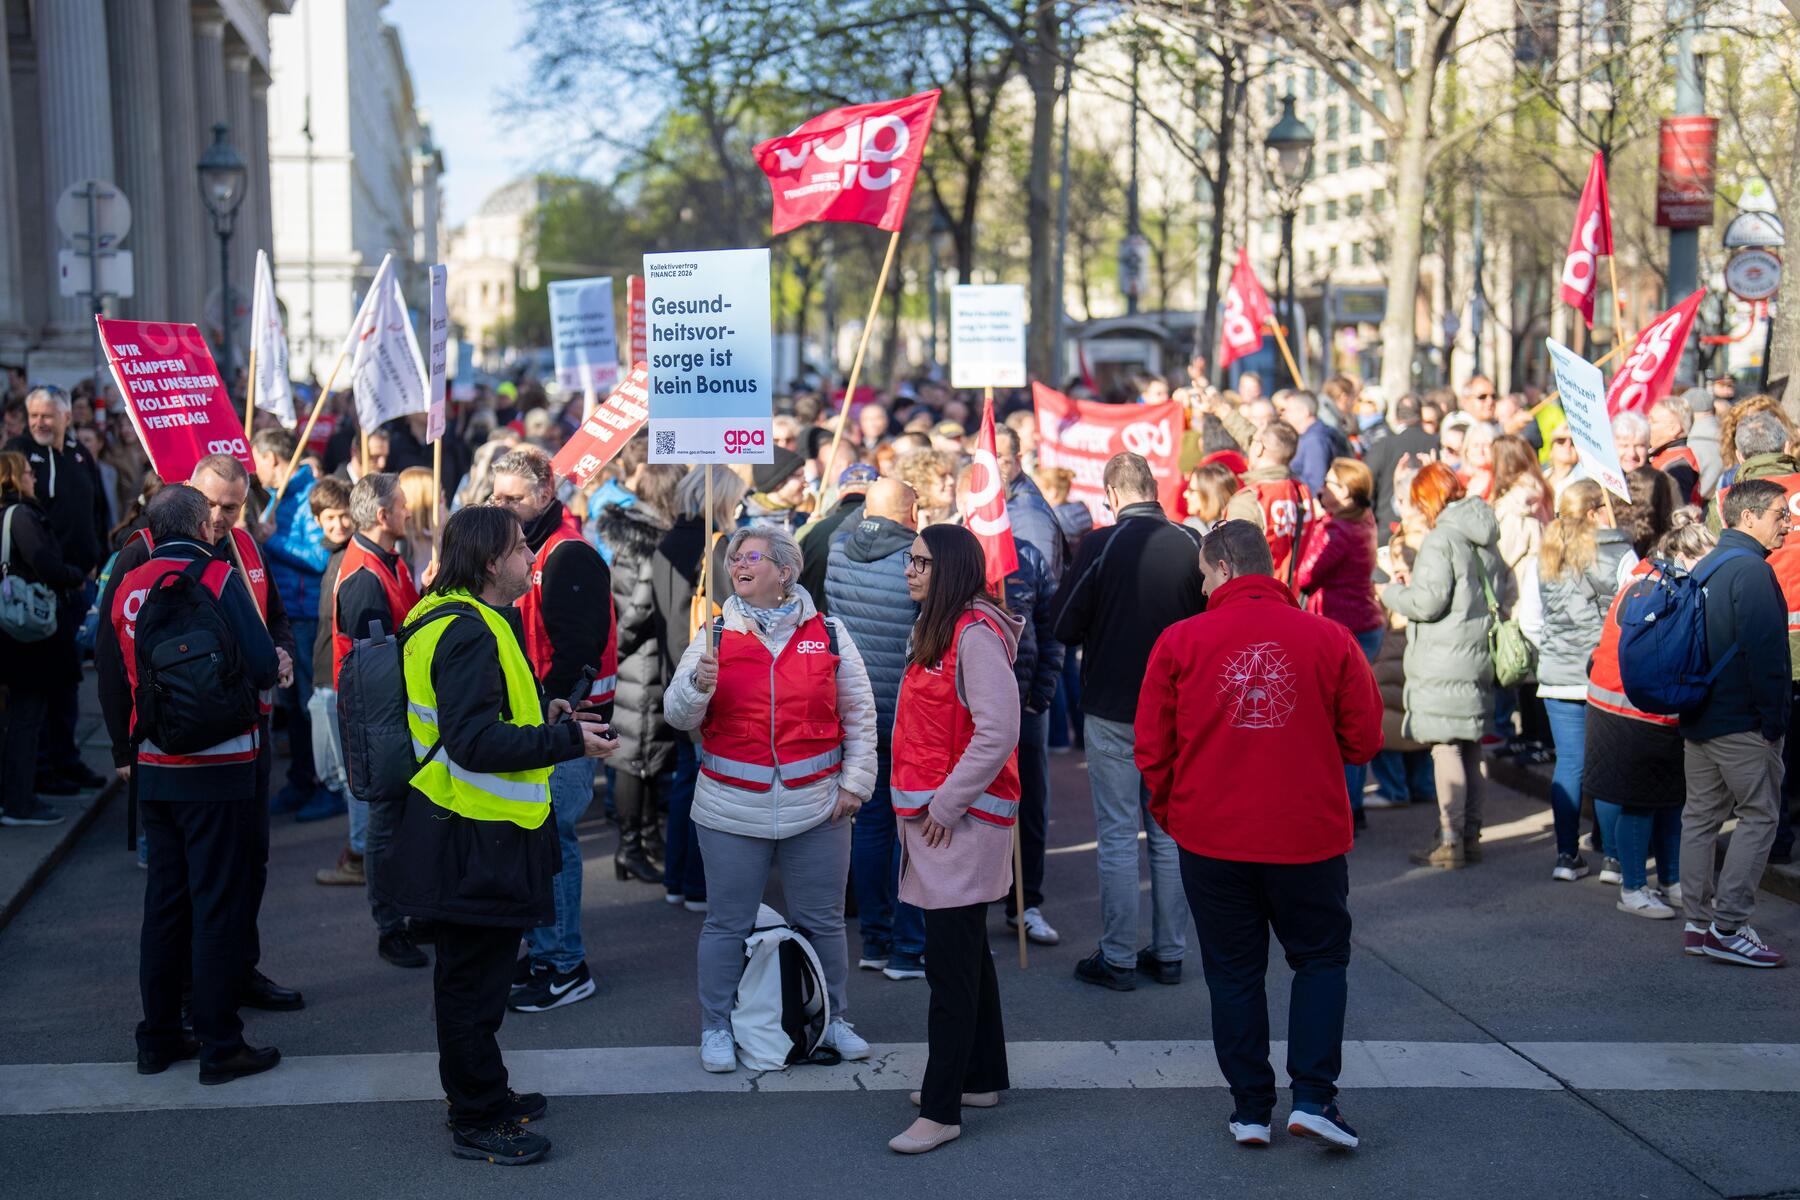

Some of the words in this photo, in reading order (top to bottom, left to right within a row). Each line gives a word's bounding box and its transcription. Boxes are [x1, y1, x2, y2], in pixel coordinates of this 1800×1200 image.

[650, 262, 698, 271] Kollektivvertrag
[650, 270, 677, 278] FINANCE
[677, 269, 693, 277] 2026
[651, 294, 732, 316] Gesund-
[652, 322, 735, 342] heitsvor-
[113, 344, 142, 357] WIR
[653, 352, 704, 372] sorge
[710, 347, 733, 367] ist
[121, 358, 187, 376] KÄMPFEN
[128, 379, 158, 394] FÜR
[159, 375, 220, 391] UNSEREN
[654, 375, 692, 395] kein
[696, 375, 758, 394] Bonus
[136, 393, 213, 412] KOLLEKTIV-
[143, 411, 210, 430] VERTRAG!
[723, 429, 765, 455] gpa
[796, 640, 826, 654] gpa
